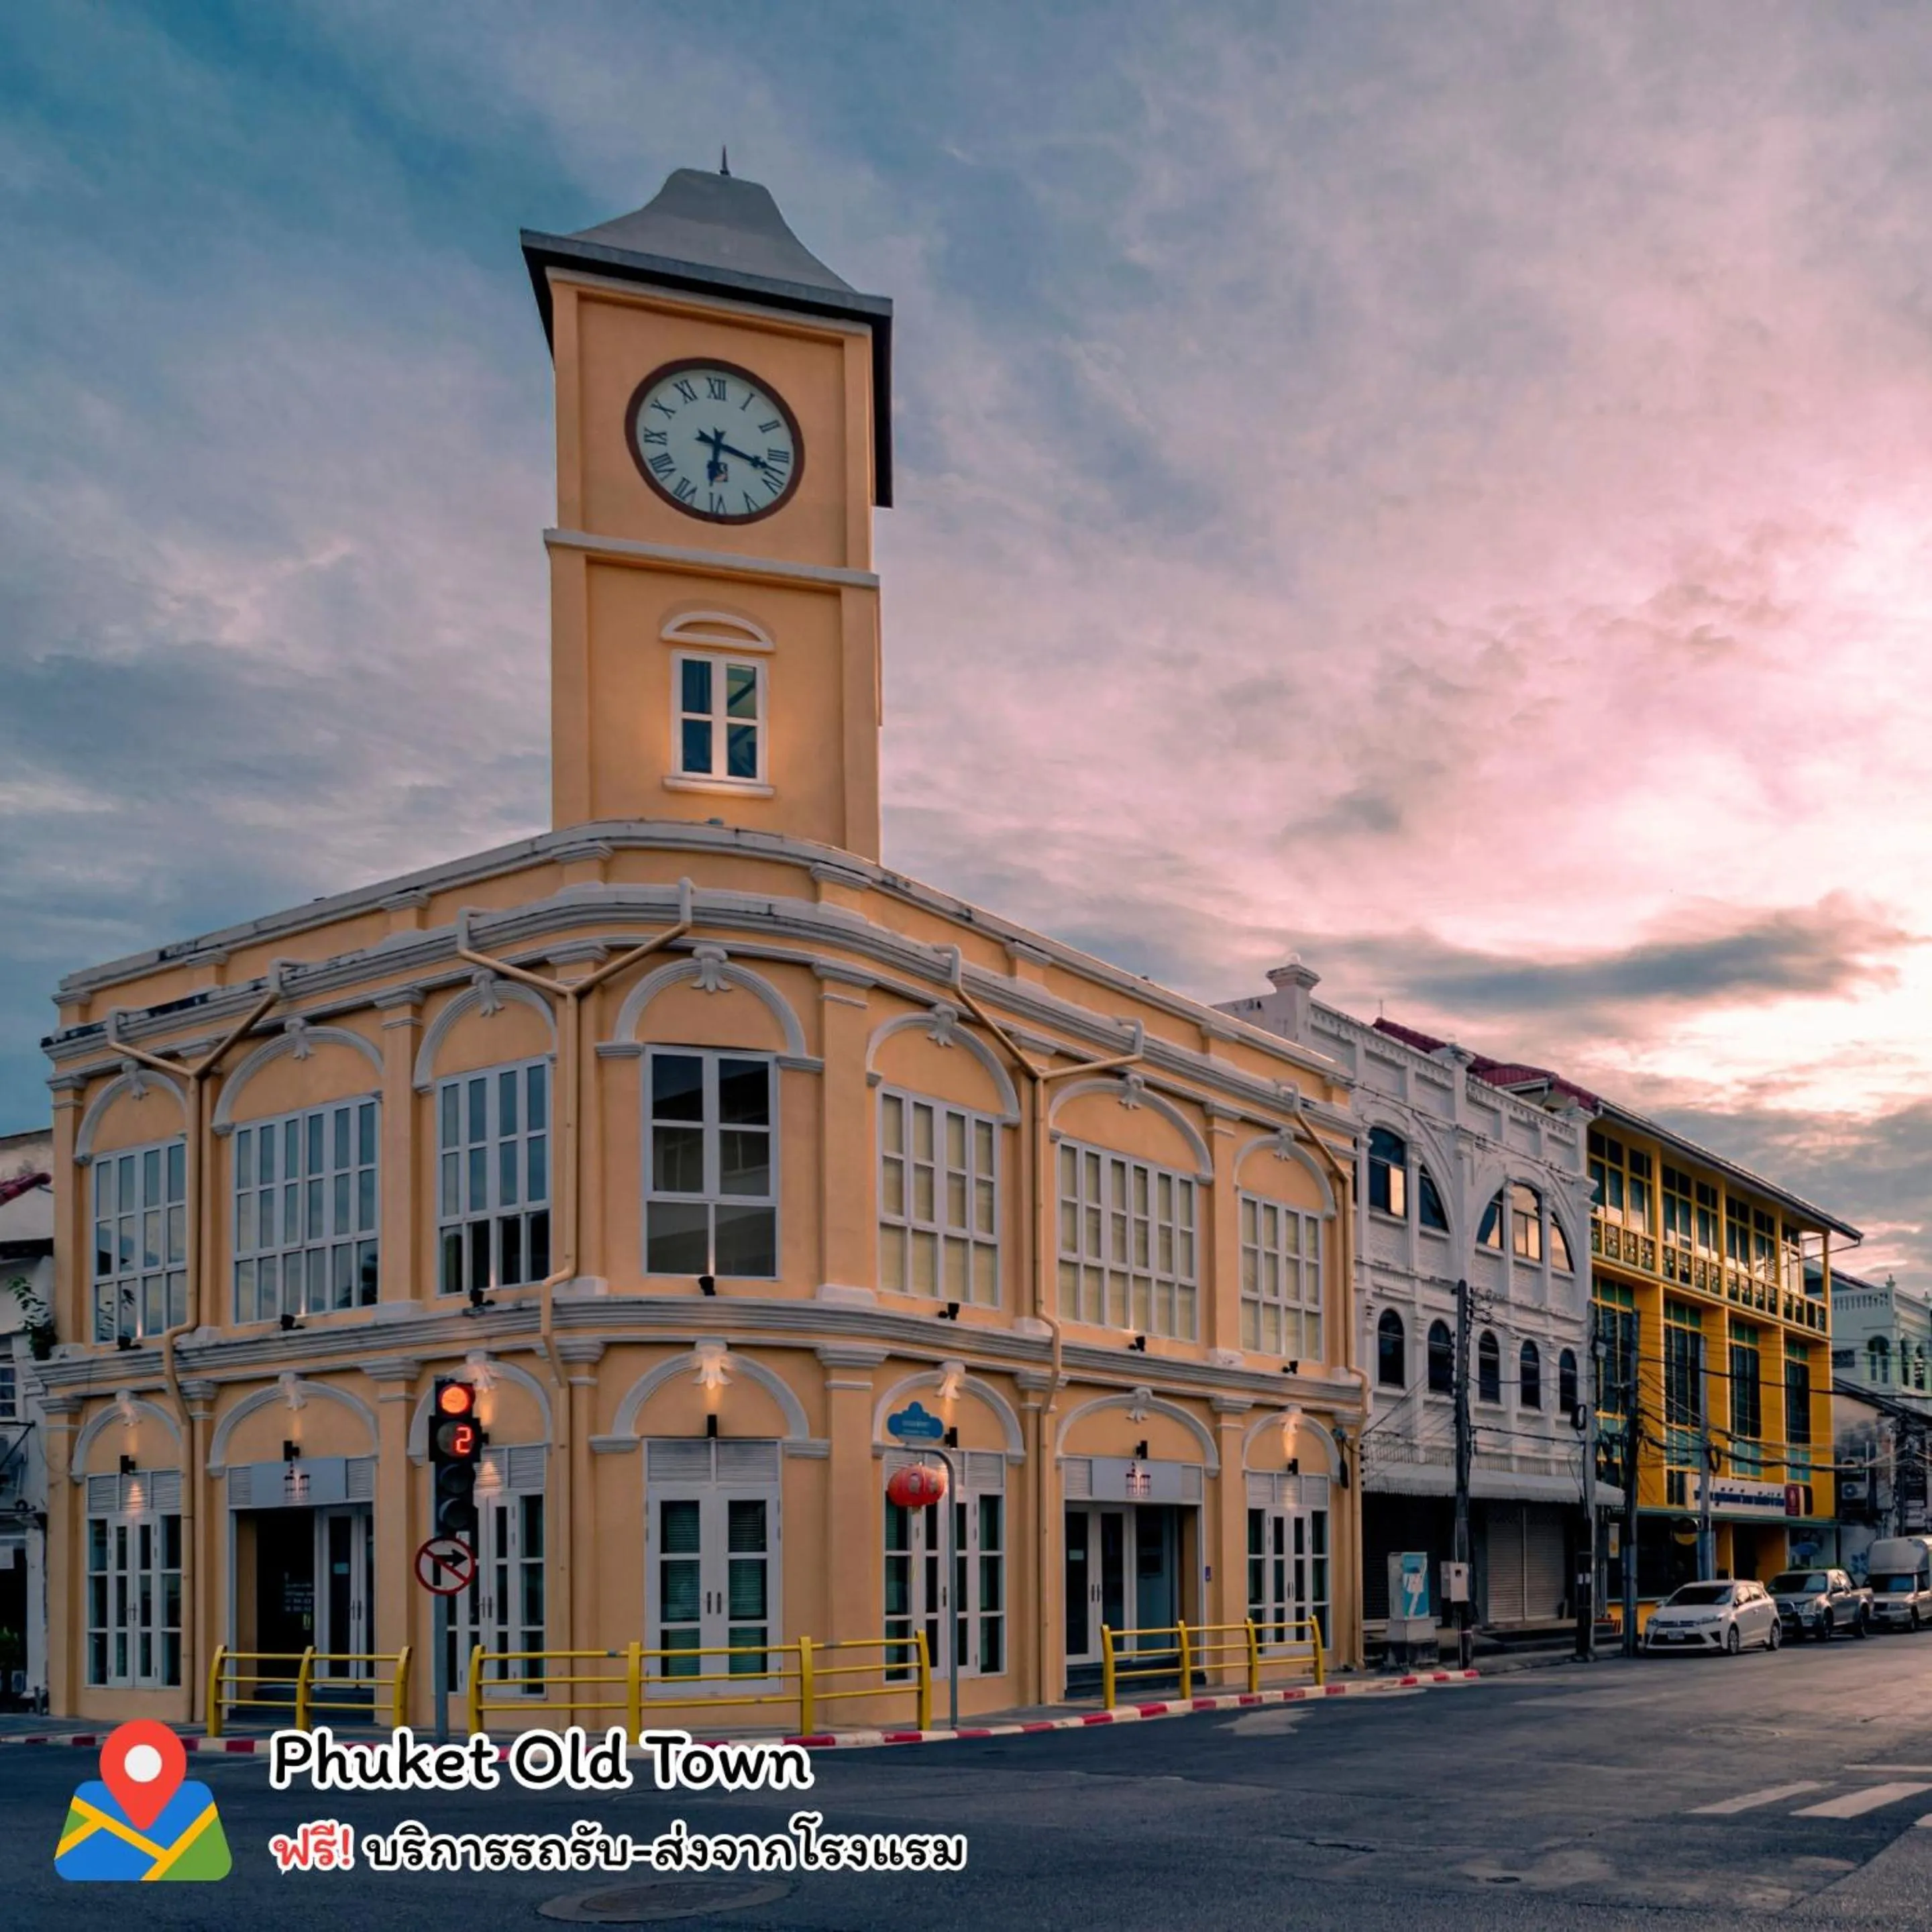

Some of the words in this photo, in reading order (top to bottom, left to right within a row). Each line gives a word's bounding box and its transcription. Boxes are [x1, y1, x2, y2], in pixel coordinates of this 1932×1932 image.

[673, 379, 698, 404] XI
[706, 377, 728, 400] XII
[650, 399, 676, 419] X
[644, 427, 667, 445] IX
[759, 419, 782, 433] II
[648, 453, 677, 480] VIII
[767, 448, 790, 464] III
[673, 477, 698, 506] VII
[709, 492, 727, 514] VI
[742, 490, 761, 513] V
[455, 1426, 472, 1454] 2
